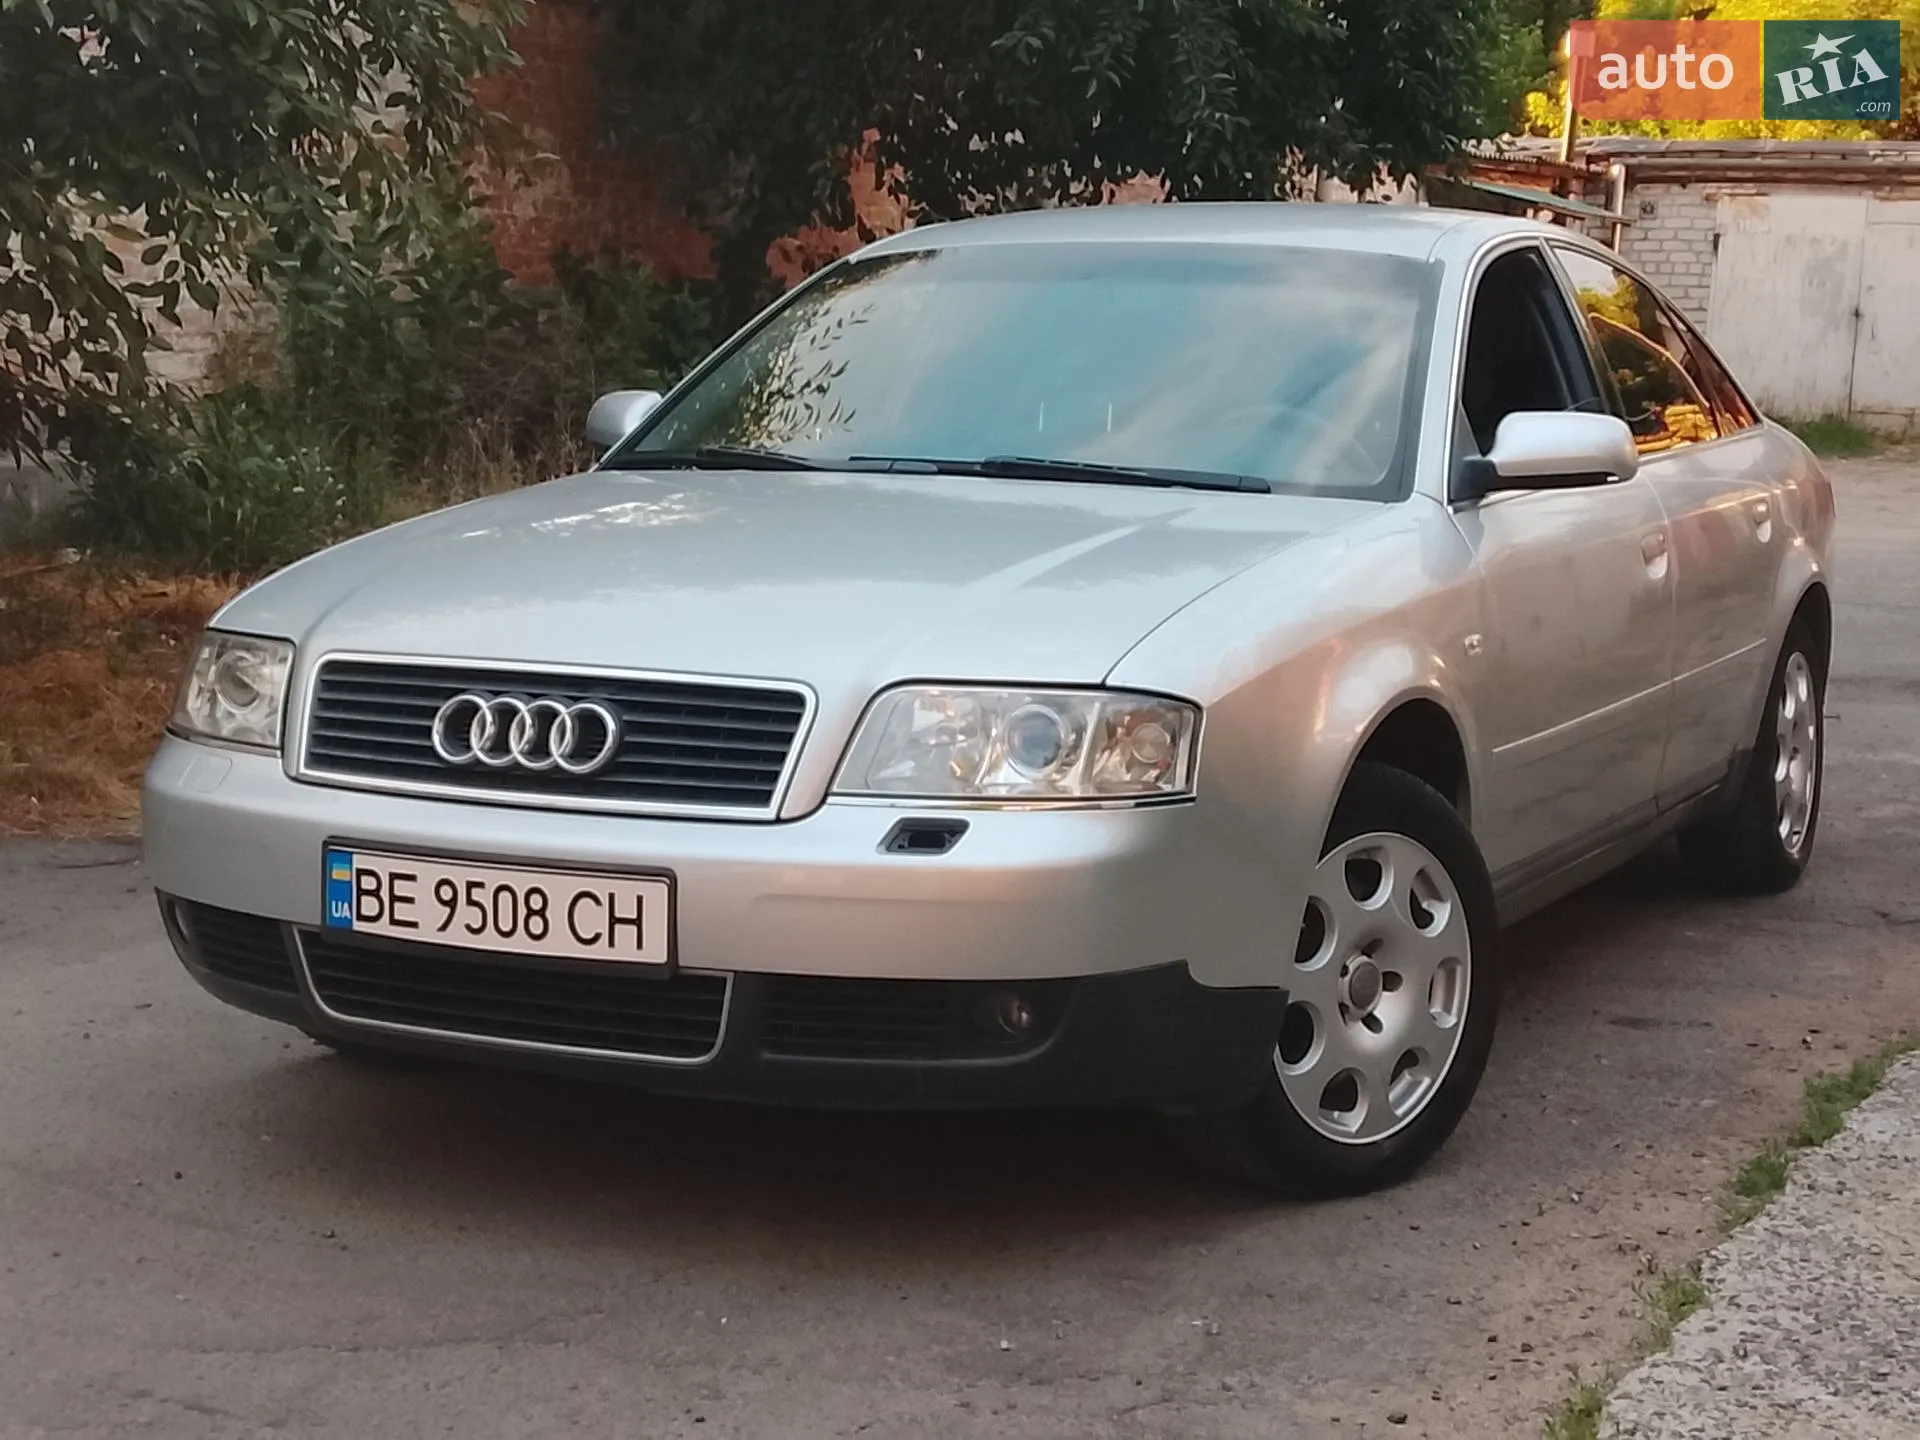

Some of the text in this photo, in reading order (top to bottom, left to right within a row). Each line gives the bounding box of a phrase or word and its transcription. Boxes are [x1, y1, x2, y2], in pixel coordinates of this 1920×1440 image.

[331, 900, 352, 920] UA
[354, 867, 645, 950] BE 9508 CH
